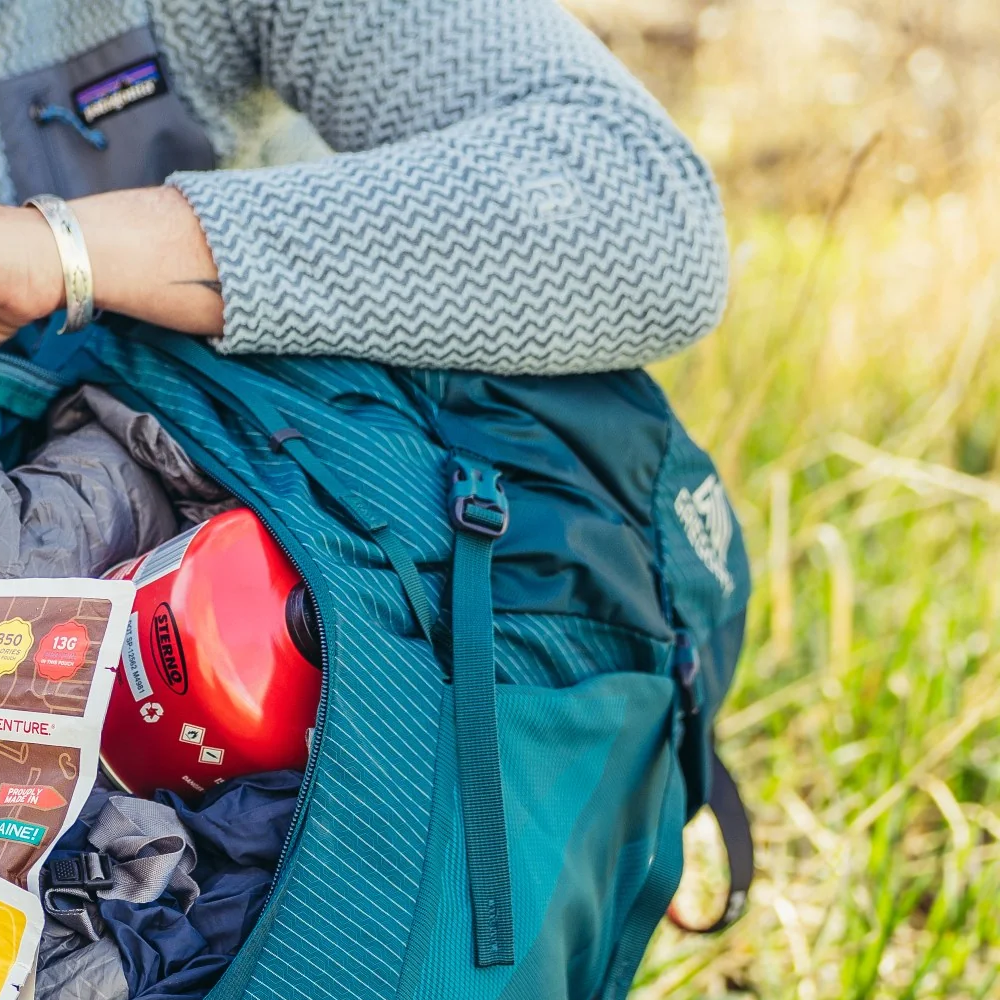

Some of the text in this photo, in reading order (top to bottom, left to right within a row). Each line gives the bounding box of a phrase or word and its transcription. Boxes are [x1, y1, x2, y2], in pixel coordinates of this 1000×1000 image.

[53, 636, 77, 650] 13G
[156, 614, 182, 684] STERNO
[7, 787, 42, 798] PROUDLY
[3, 794, 38, 804] MADE IN
